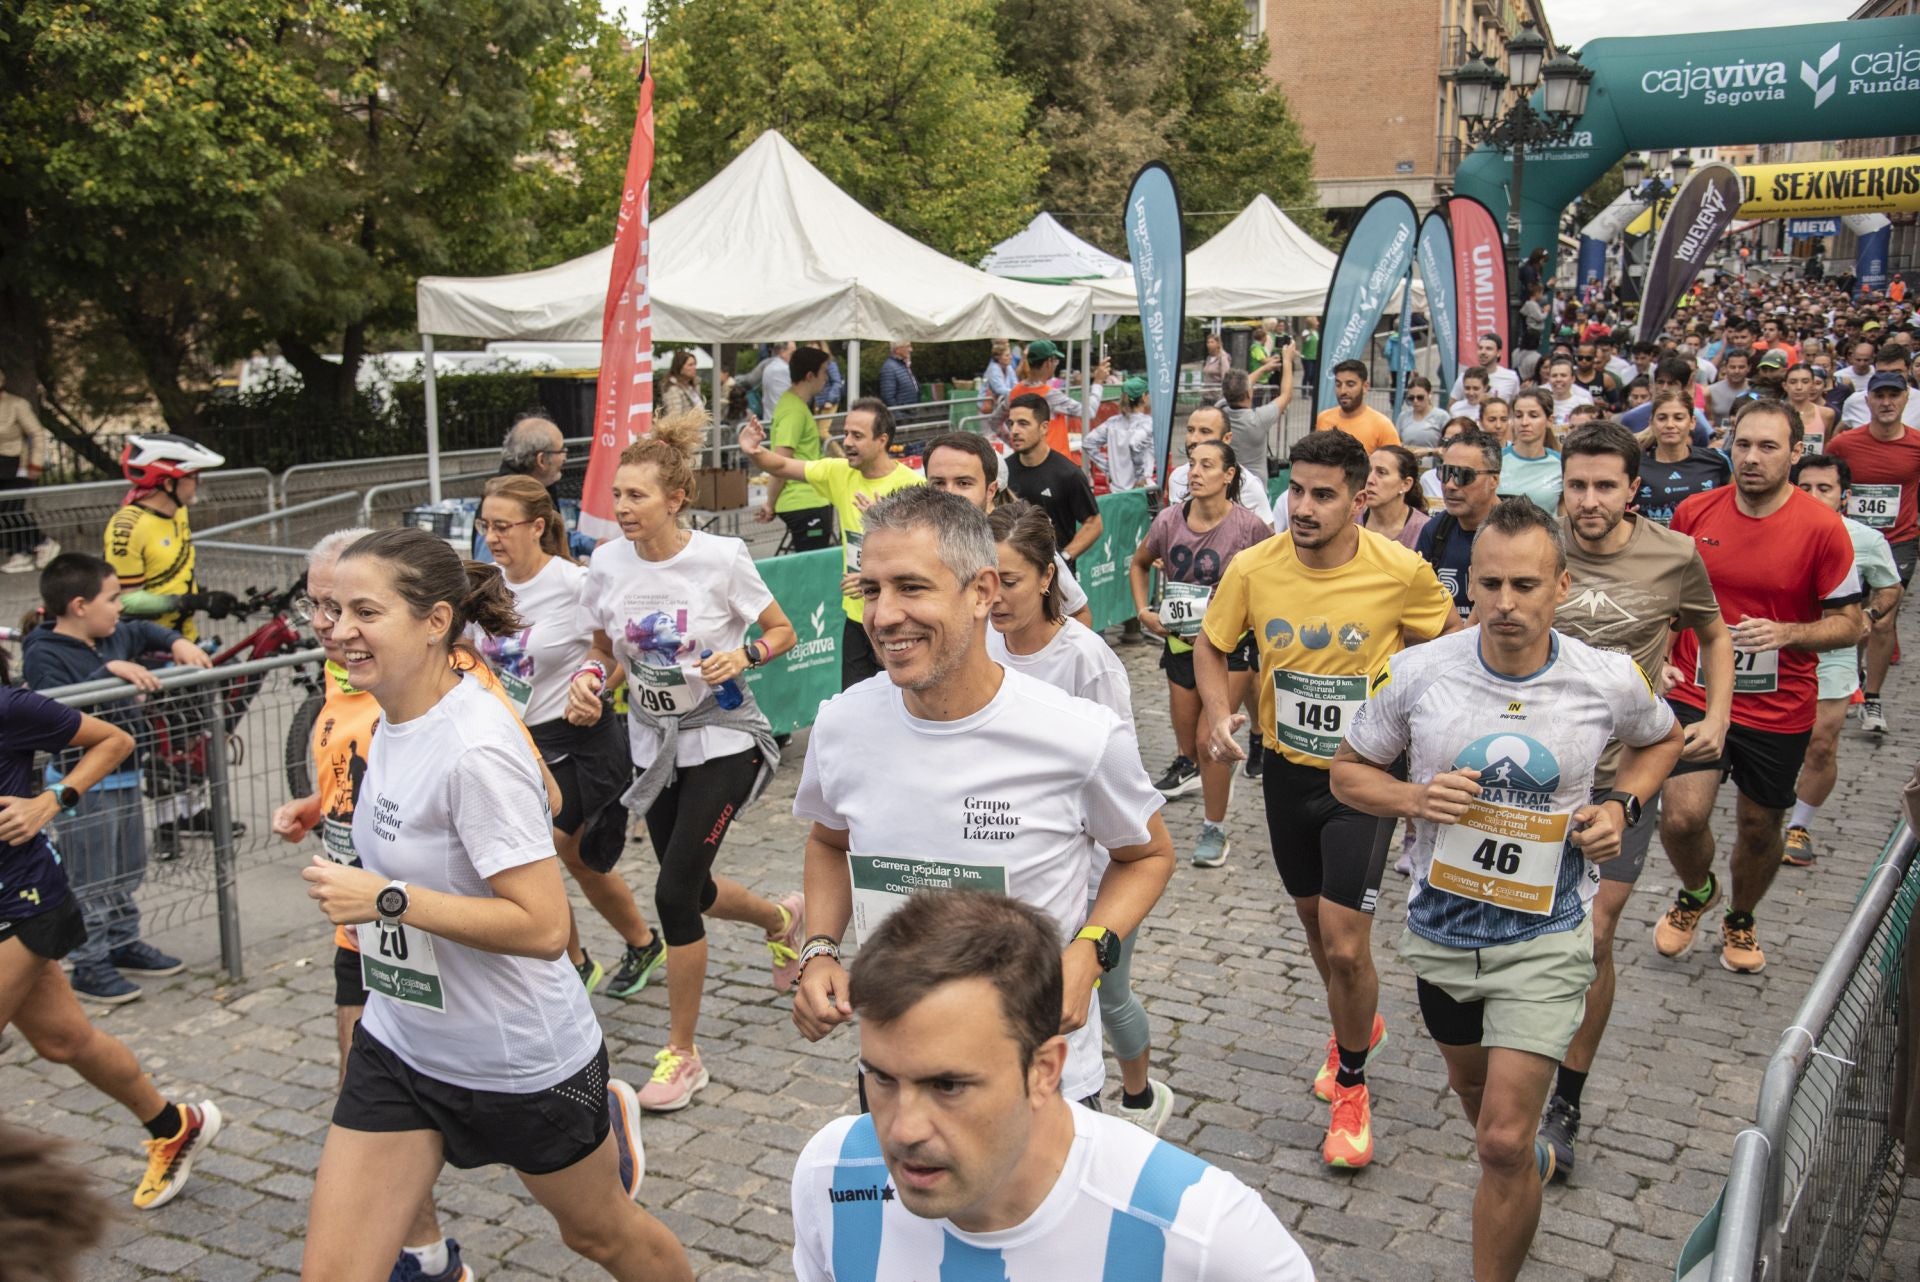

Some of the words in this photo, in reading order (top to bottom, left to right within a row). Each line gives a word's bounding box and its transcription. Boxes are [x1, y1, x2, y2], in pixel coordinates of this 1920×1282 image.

[1851, 44, 1920, 80] caja
[1641, 58, 1787, 98] cajaviva
[1847, 76, 1920, 95] Funda
[1704, 86, 1785, 107] Segovia
[1772, 165, 1920, 202] SEXMEROS
[1792, 220, 1837, 233] META
[1858, 499, 1887, 514] 346
[1169, 543, 1221, 585] 90
[1168, 600, 1193, 619] 361
[785, 636, 835, 662] cajaviva
[1287, 672, 1309, 684] Carrera
[1309, 679, 1335, 687] popular
[638, 684, 676, 712] 296
[1293, 688, 1314, 698] CONTRA
[1295, 701, 1341, 732] 149
[1508, 703, 1522, 711] IN
[376, 791, 400, 813] Grupo
[963, 796, 1011, 813] Grupo
[1473, 787, 1504, 802] RA
[1506, 789, 1552, 804] TRAIL
[373, 805, 403, 829] Tejedor
[963, 811, 1022, 828] Tejedor
[1469, 803, 1495, 814] arrera
[1496, 809, 1528, 821] popular
[1530, 815, 1536, 823] 4
[1537, 816, 1552, 825] km.
[1485, 816, 1528, 831] cajarural
[963, 825, 1016, 840] Lázaro
[1468, 819, 1498, 833] CONTRA
[1499, 826, 1508, 835] EL
[1509, 829, 1541, 841] CÁNCER
[1472, 838, 1522, 875] 46
[872, 858, 911, 872] Carrera
[912, 864, 952, 877] popular
[953, 867, 961, 877] 9
[962, 868, 982, 880] km.
[901, 874, 952, 889] cajarural
[1442, 871, 1480, 889] cajaviva
[1496, 885, 1540, 901] cajarural
[400, 977, 432, 993] cajarural
[828, 1184, 878, 1204] luanvi
